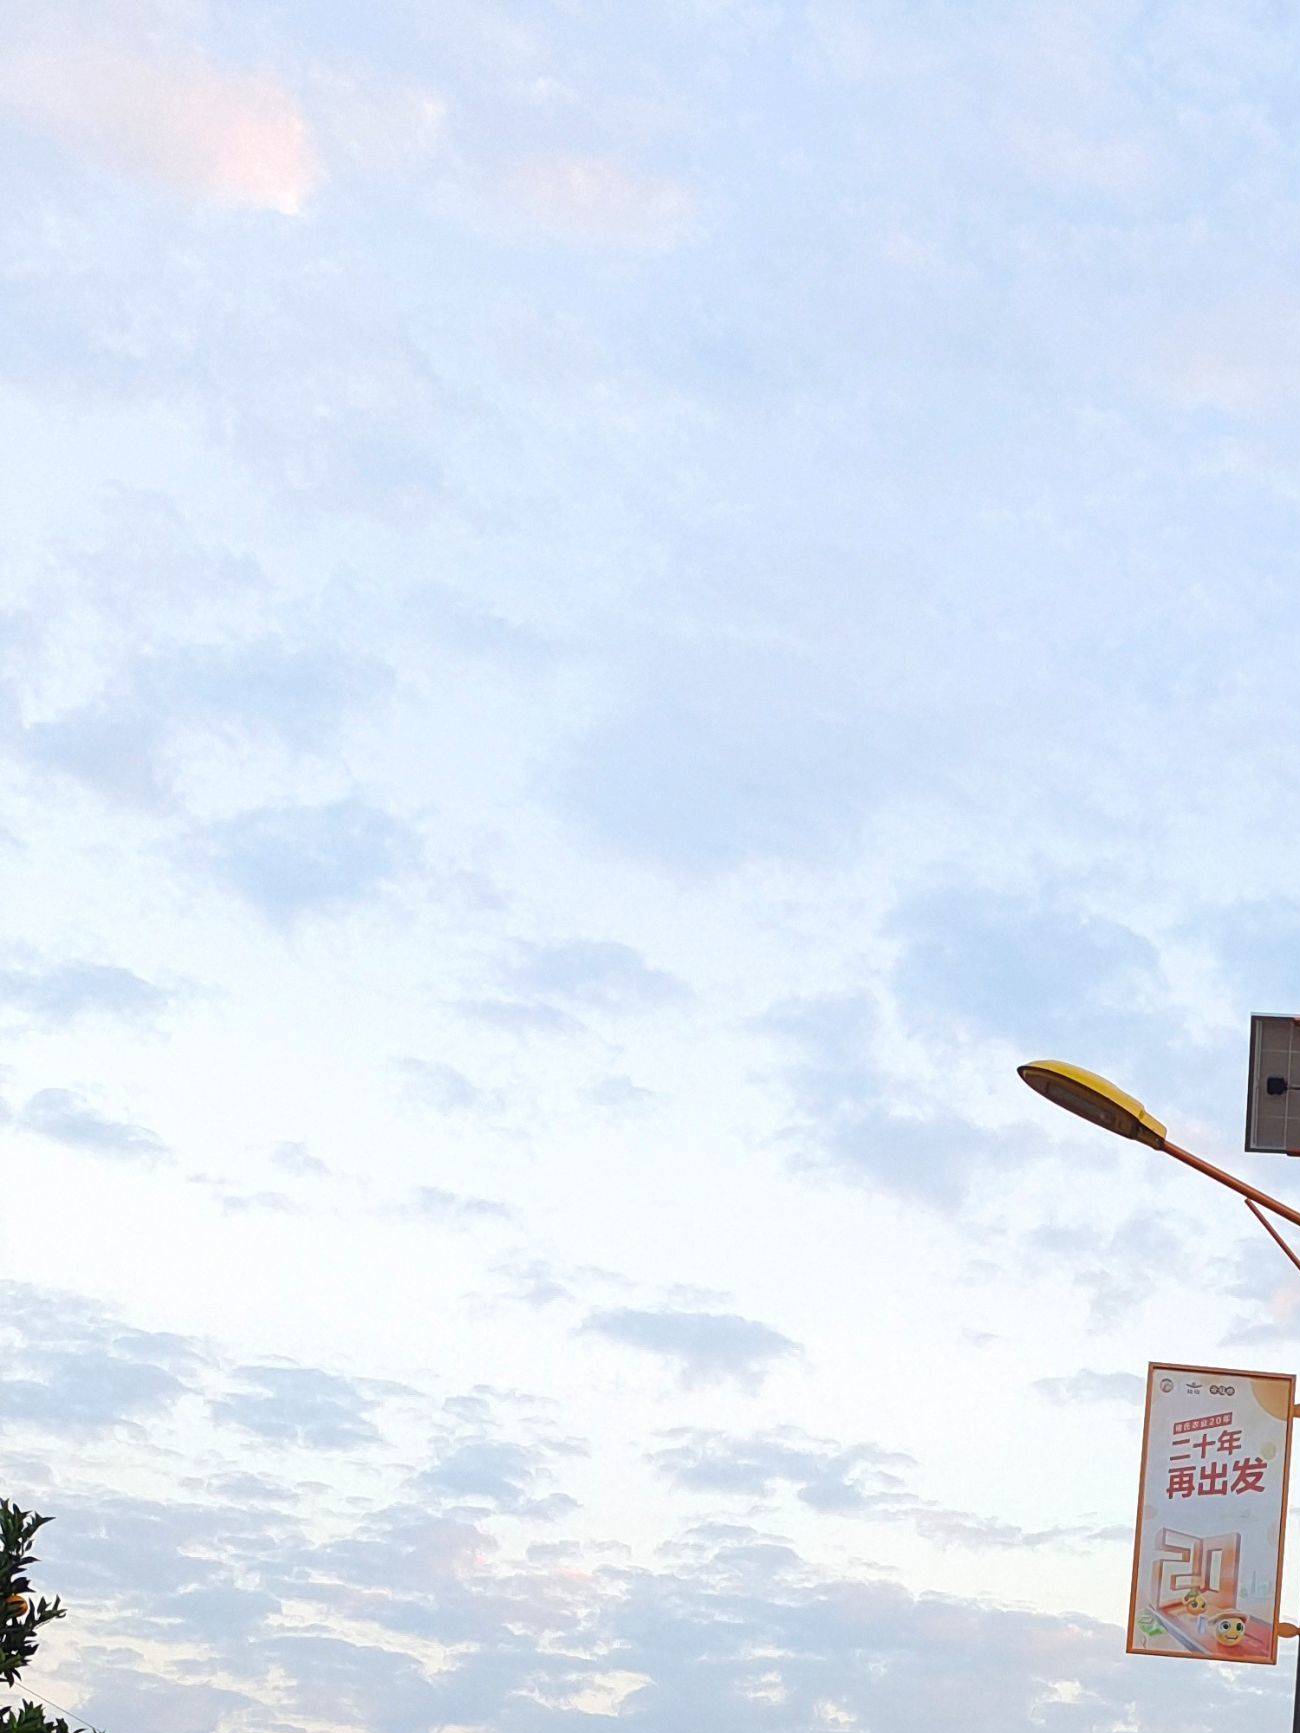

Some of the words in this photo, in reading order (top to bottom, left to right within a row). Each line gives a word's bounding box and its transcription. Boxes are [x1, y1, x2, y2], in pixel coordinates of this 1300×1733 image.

[1169, 1429, 1242, 1461] 二十年
[1166, 1456, 1268, 1500] 再出发
[1153, 1527, 1241, 1610] 20
